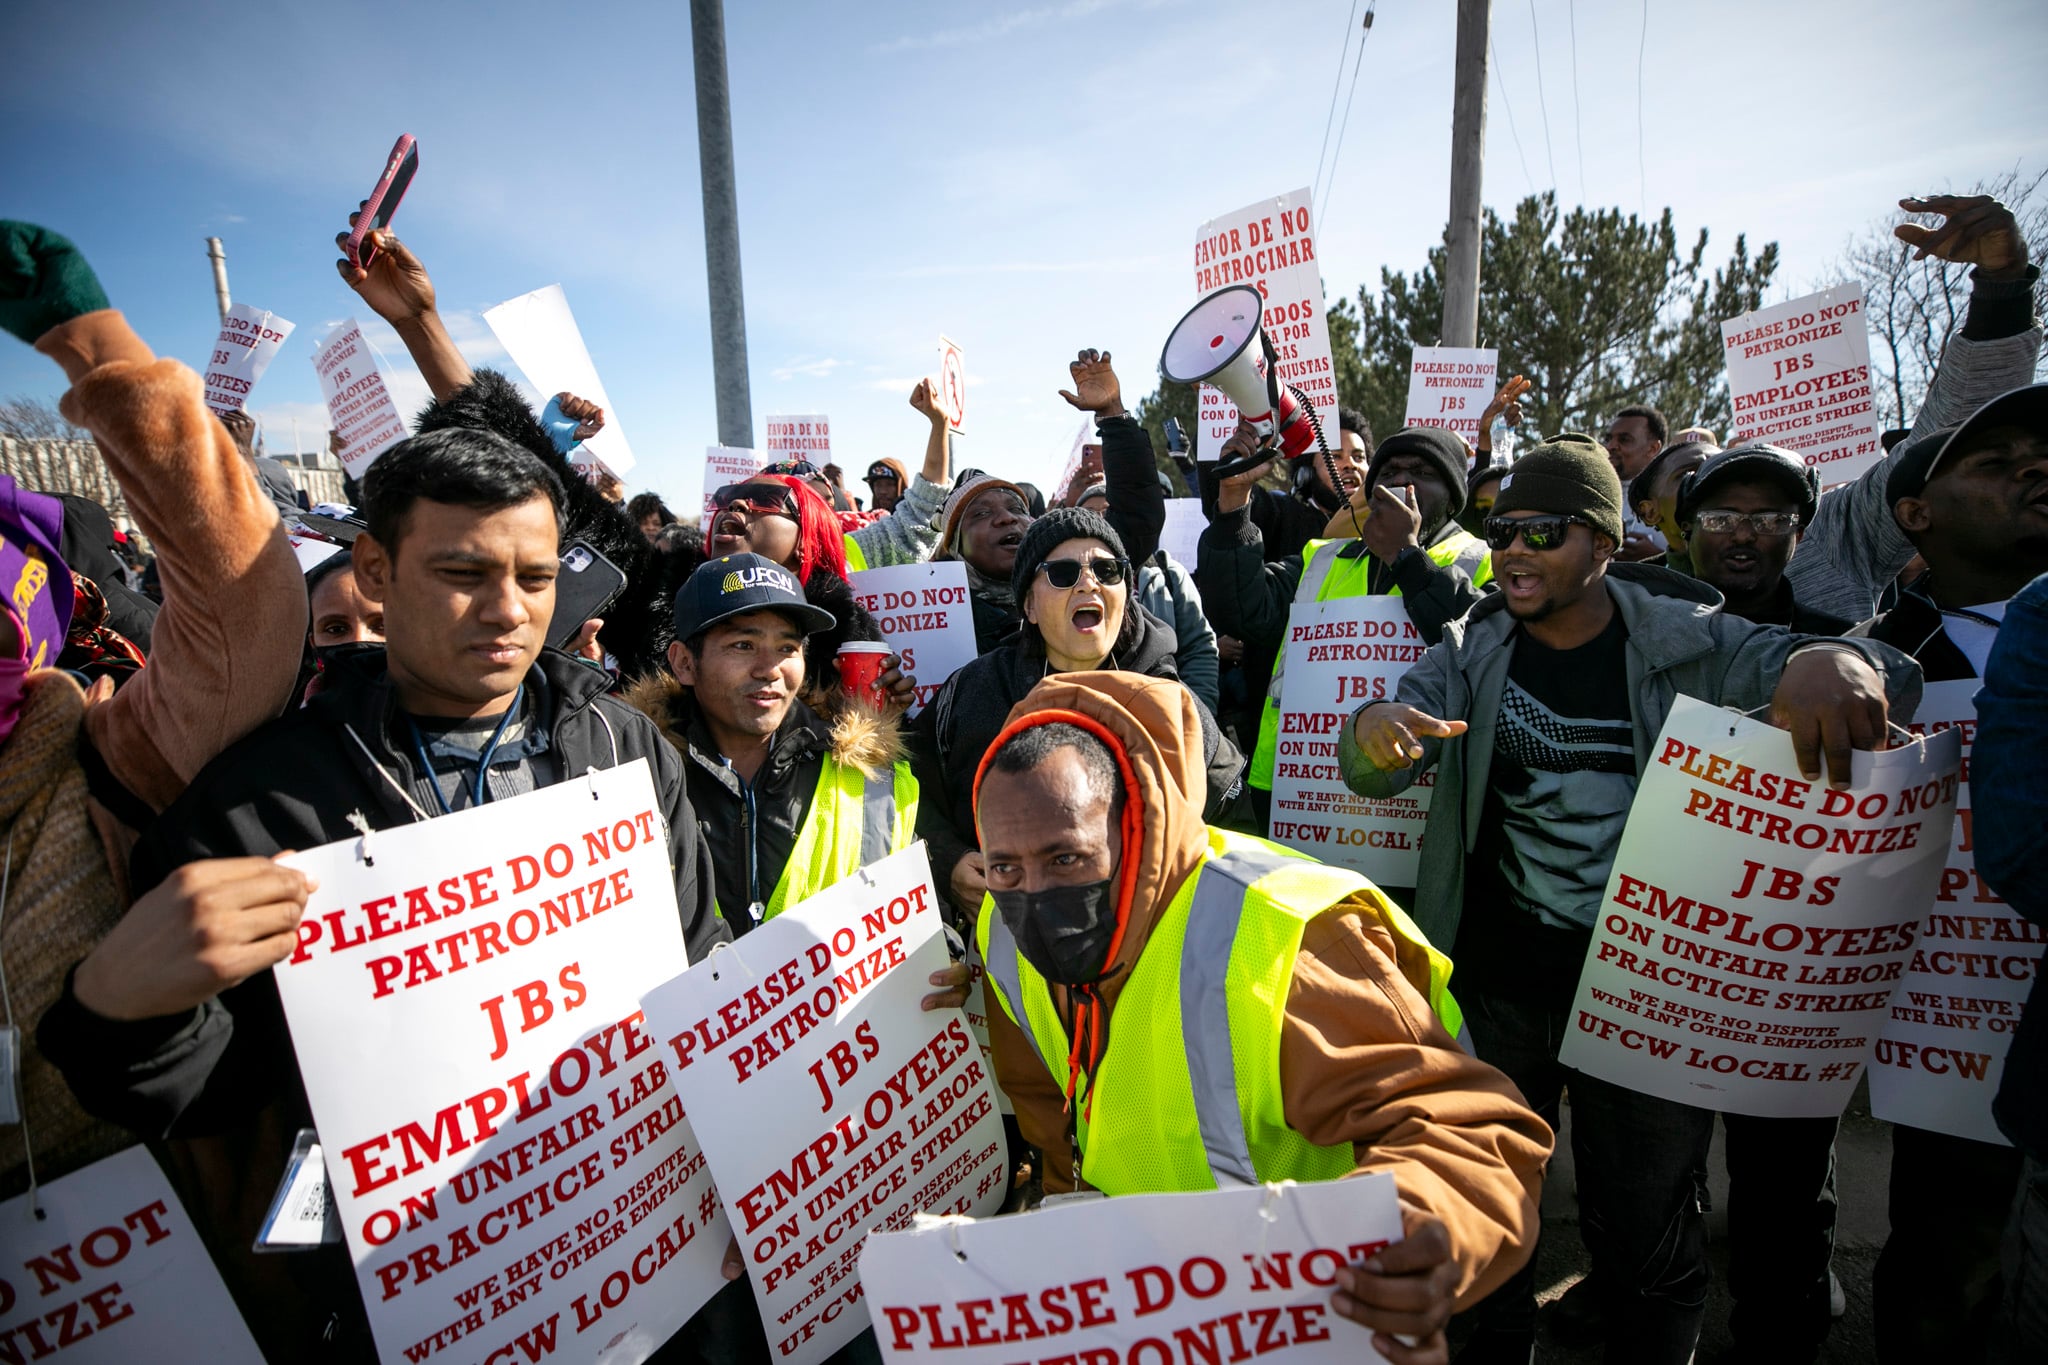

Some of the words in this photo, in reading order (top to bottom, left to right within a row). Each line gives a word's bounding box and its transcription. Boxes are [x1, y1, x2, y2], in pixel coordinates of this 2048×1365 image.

[1195, 228, 1242, 267] FAVOR
[1248, 217, 1274, 247] DE
[1280, 206, 1309, 238] NO
[1196, 237, 1314, 293] PRATROCINAR
[231, 318, 248, 330] DO
[250, 324, 284, 343] NOT
[1283, 322, 1310, 342] POR
[1726, 322, 1784, 348] PLEASE
[1787, 313, 1814, 331] DO
[1819, 300, 1860, 322] NOT
[1744, 322, 1842, 359] PATRONIZE
[212, 350, 230, 365] BS
[333, 368, 352, 388] JBS
[1414, 363, 1456, 374] PLEASE
[1457, 364, 1473, 374] DO
[1476, 364, 1496, 374] NOT
[1774, 353, 1814, 380] JBS
[204, 372, 252, 394] OYEES
[1203, 395, 1218, 405] NO
[1425, 377, 1484, 388] PATRONIZE
[1440, 396, 1466, 412] JBS
[1734, 365, 1868, 412] EMPLOYEES
[1736, 412, 1756, 426] ON
[1759, 400, 1815, 422] UNFAIR
[1818, 386, 1871, 408] LABOR
[768, 424, 795, 436] FAVOR
[799, 424, 811, 436] DE
[816, 424, 828, 436] NO
[1202, 410, 1224, 420] CON
[1738, 416, 1812, 440] PRACTICE
[1816, 400, 1872, 423] STRIKE
[1773, 436, 1796, 447] HAVE
[1798, 432, 1812, 442] NO
[1814, 424, 1854, 438] DISPUTE
[1788, 438, 1818, 450] OTHER
[1820, 426, 1872, 446] EMPLOYER
[706, 456, 739, 464] PLEASE
[741, 458, 754, 466] DO
[768, 438, 830, 450] PRATROCINAR
[1804, 446, 1852, 467] OCAL
[1856, 440, 1876, 455] #7
[884, 590, 916, 610] DO
[922, 587, 966, 607] NOT
[880, 612, 948, 635] ONIZE
[1292, 622, 1358, 642] PLEASE
[1363, 621, 1397, 638] DO
[1336, 676, 1386, 703] JBS
[1280, 741, 1304, 756] ON
[1298, 791, 1314, 800] WE
[1316, 792, 1346, 804] HAVE
[1348, 795, 1367, 804] NO
[1369, 797, 1418, 808] DISPUTE
[1658, 737, 1810, 809] PLEASE
[1816, 788, 1888, 819] DO
[1894, 773, 1957, 816] NOT
[1278, 800, 1304, 811] WITH
[1307, 803, 1330, 814] ANY
[1332, 804, 1373, 816] OTHER
[1684, 788, 1922, 855] PATRONIZE
[1273, 822, 1332, 843] UFCW
[1336, 828, 1412, 850] LOCAL
[289, 866, 499, 966] PLEASE
[506, 843, 574, 894] DO
[582, 810, 654, 866] NOT
[1731, 859, 1841, 906] JBS
[366, 868, 634, 1000] PATRONIZE
[1613, 873, 1920, 957] EMPLOYEES
[1606, 914, 1655, 947] ON
[1662, 933, 1788, 982] UNFAIR
[1794, 961, 1903, 985] LABOR
[1909, 950, 2042, 980] ACTIC
[668, 958, 805, 1070] PLEASE
[805, 927, 856, 978] DO
[861, 883, 929, 942] NOT
[1597, 941, 1770, 1007] PRACTICE
[1774, 990, 1892, 1012] STRIKE
[480, 962, 587, 1060] JBS
[728, 936, 906, 1084] PATRONIZE
[1590, 986, 1641, 1015] WITH
[1643, 1007, 1686, 1028] ANY
[1688, 1022, 1758, 1044] OTHER
[1761, 1037, 1866, 1050] EMPLOYER
[1629, 988, 1660, 1008] WE
[1662, 1000, 1717, 1024] HAVE
[1719, 1016, 1752, 1030] NO
[1756, 1022, 1840, 1038] DISPUTE
[1890, 1006, 1928, 1024] ITH
[1932, 1012, 1981, 1030] ANY
[1907, 992, 1943, 1009] WE
[1947, 996, 2013, 1016] HAVE
[808, 1020, 880, 1114] JBS
[1577, 1010, 1682, 1060] UFCW
[1685, 1048, 1811, 1082] LOCAL
[1818, 1061, 1860, 1082] #7
[1875, 1038, 1992, 1081] UFCW
[342, 1009, 655, 1198] EMPLOYE
[735, 1017, 970, 1236] EMPLOYEES
[362, 1187, 438, 1246] ON
[448, 1104, 604, 1204] UNFAIR
[608, 1060, 670, 1120] LAB
[754, 1214, 800, 1264] ON
[804, 1130, 907, 1222] UNFAIR
[908, 1060, 984, 1140] LABOR
[375, 1151, 604, 1302] PRACTICE
[610, 1094, 687, 1170] STRI
[762, 1166, 908, 1296] PRACTICE
[910, 1092, 992, 1176] STRIKE
[454, 1274, 500, 1311] WE
[504, 1232, 572, 1286] HAVE
[575, 1208, 610, 1242] NO
[614, 1146, 688, 1216] DISPUTE
[777, 1283, 826, 1325] WITH
[922, 1142, 999, 1213] EMPLOYER
[808, 1260, 837, 1287] WE
[885, 1203, 909, 1228] NO
[912, 1149, 972, 1206] DISPUTE
[24, 1199, 172, 1297] NOT
[402, 1308, 486, 1365] WITH
[491, 1272, 544, 1320] ANY
[550, 1217, 628, 1281] OTHER
[630, 1152, 707, 1228] EMPLOYE
[777, 1281, 864, 1356] UFCW
[976, 1164, 1004, 1200] #7
[570, 1214, 696, 1334] LOCAL
[882, 1278, 1116, 1351] PLEASE
[1125, 1256, 1226, 1317] DO
